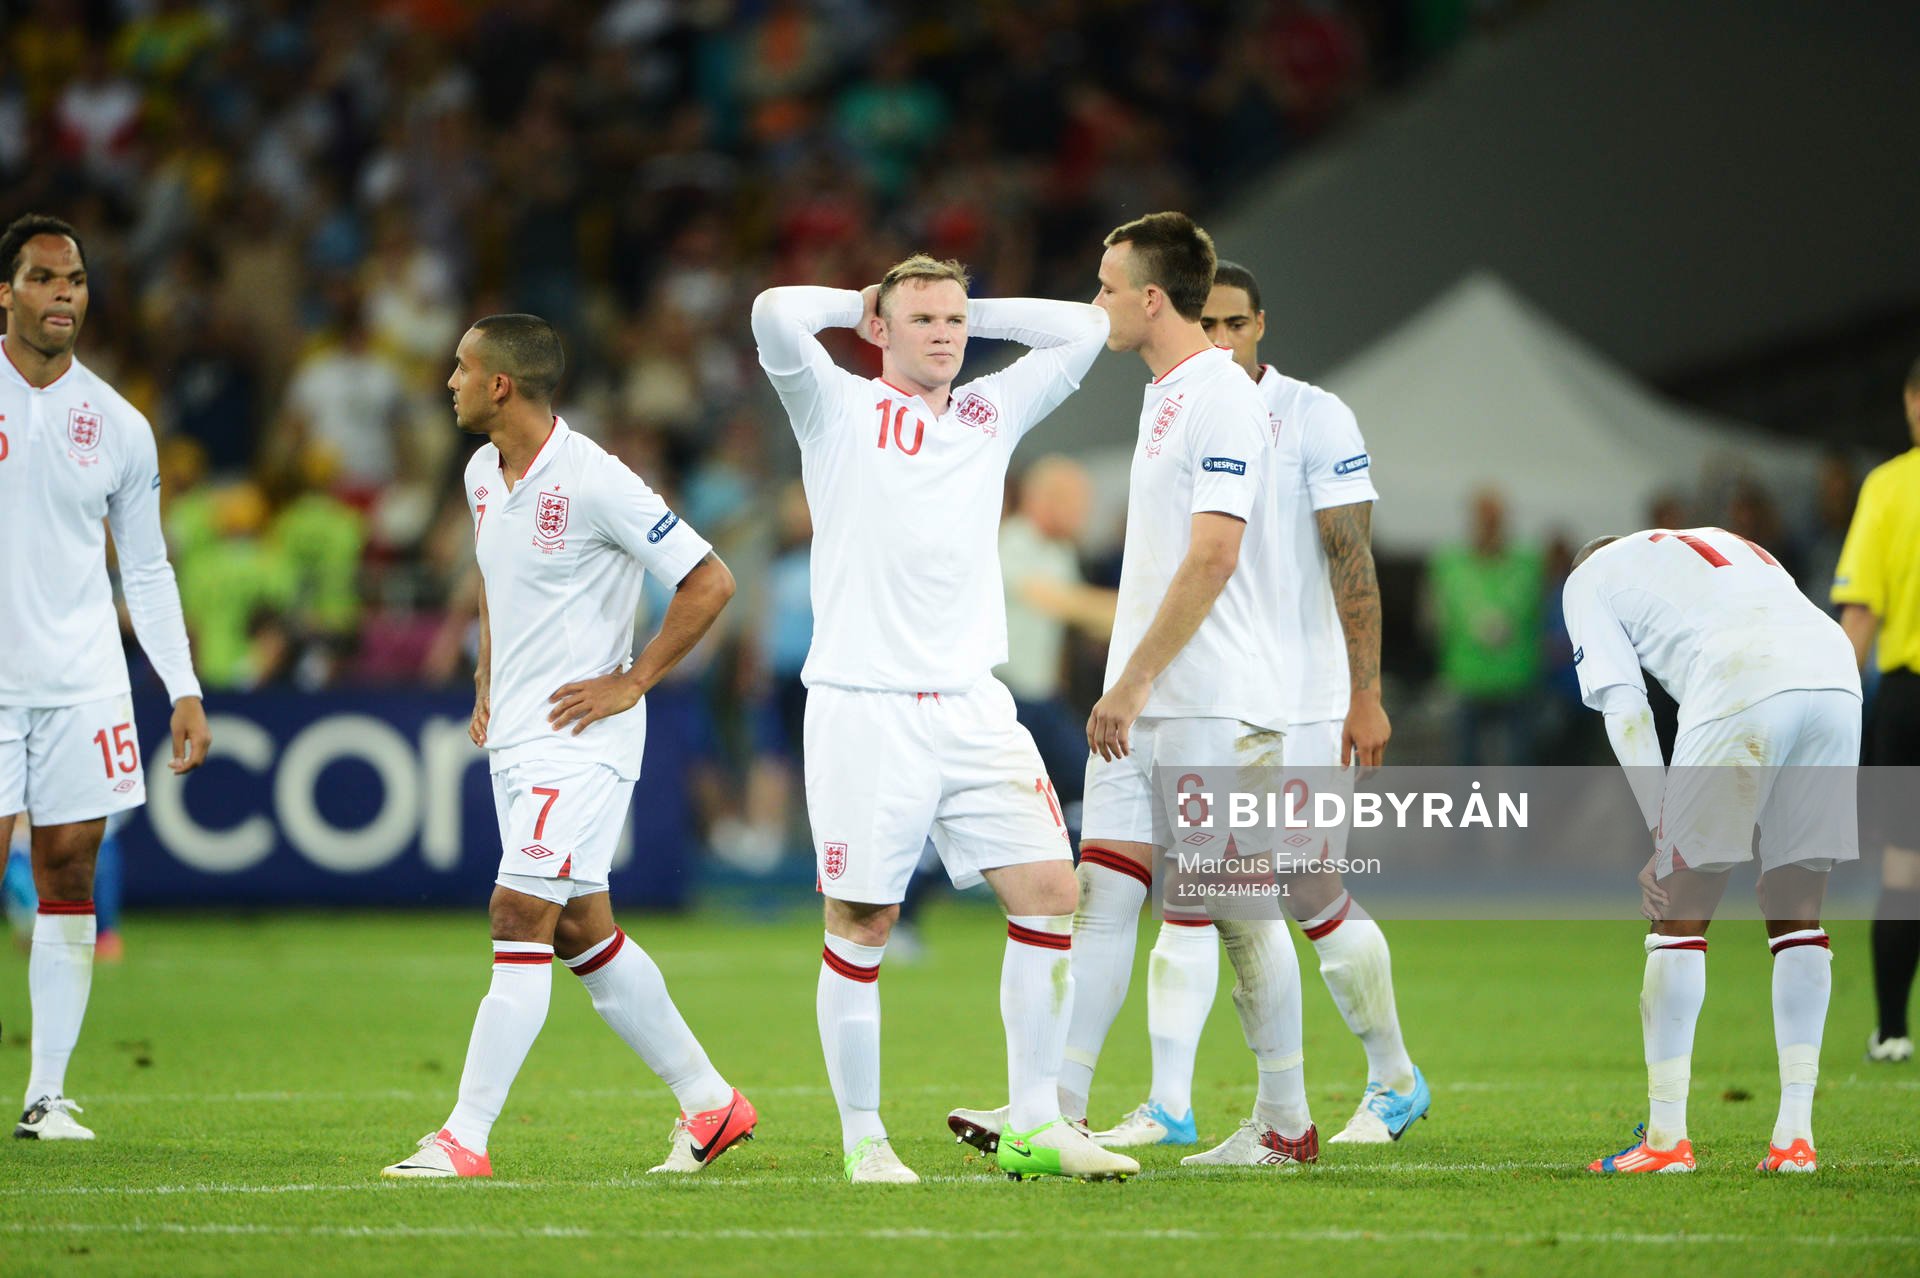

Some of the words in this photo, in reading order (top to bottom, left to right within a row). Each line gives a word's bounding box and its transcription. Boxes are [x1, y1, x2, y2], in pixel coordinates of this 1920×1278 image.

[876, 399, 925, 456] 10
[1213, 460, 1244, 472] RESPECT
[476, 504, 486, 546] 7
[93, 722, 138, 779] 15
[532, 786, 560, 841] 7
